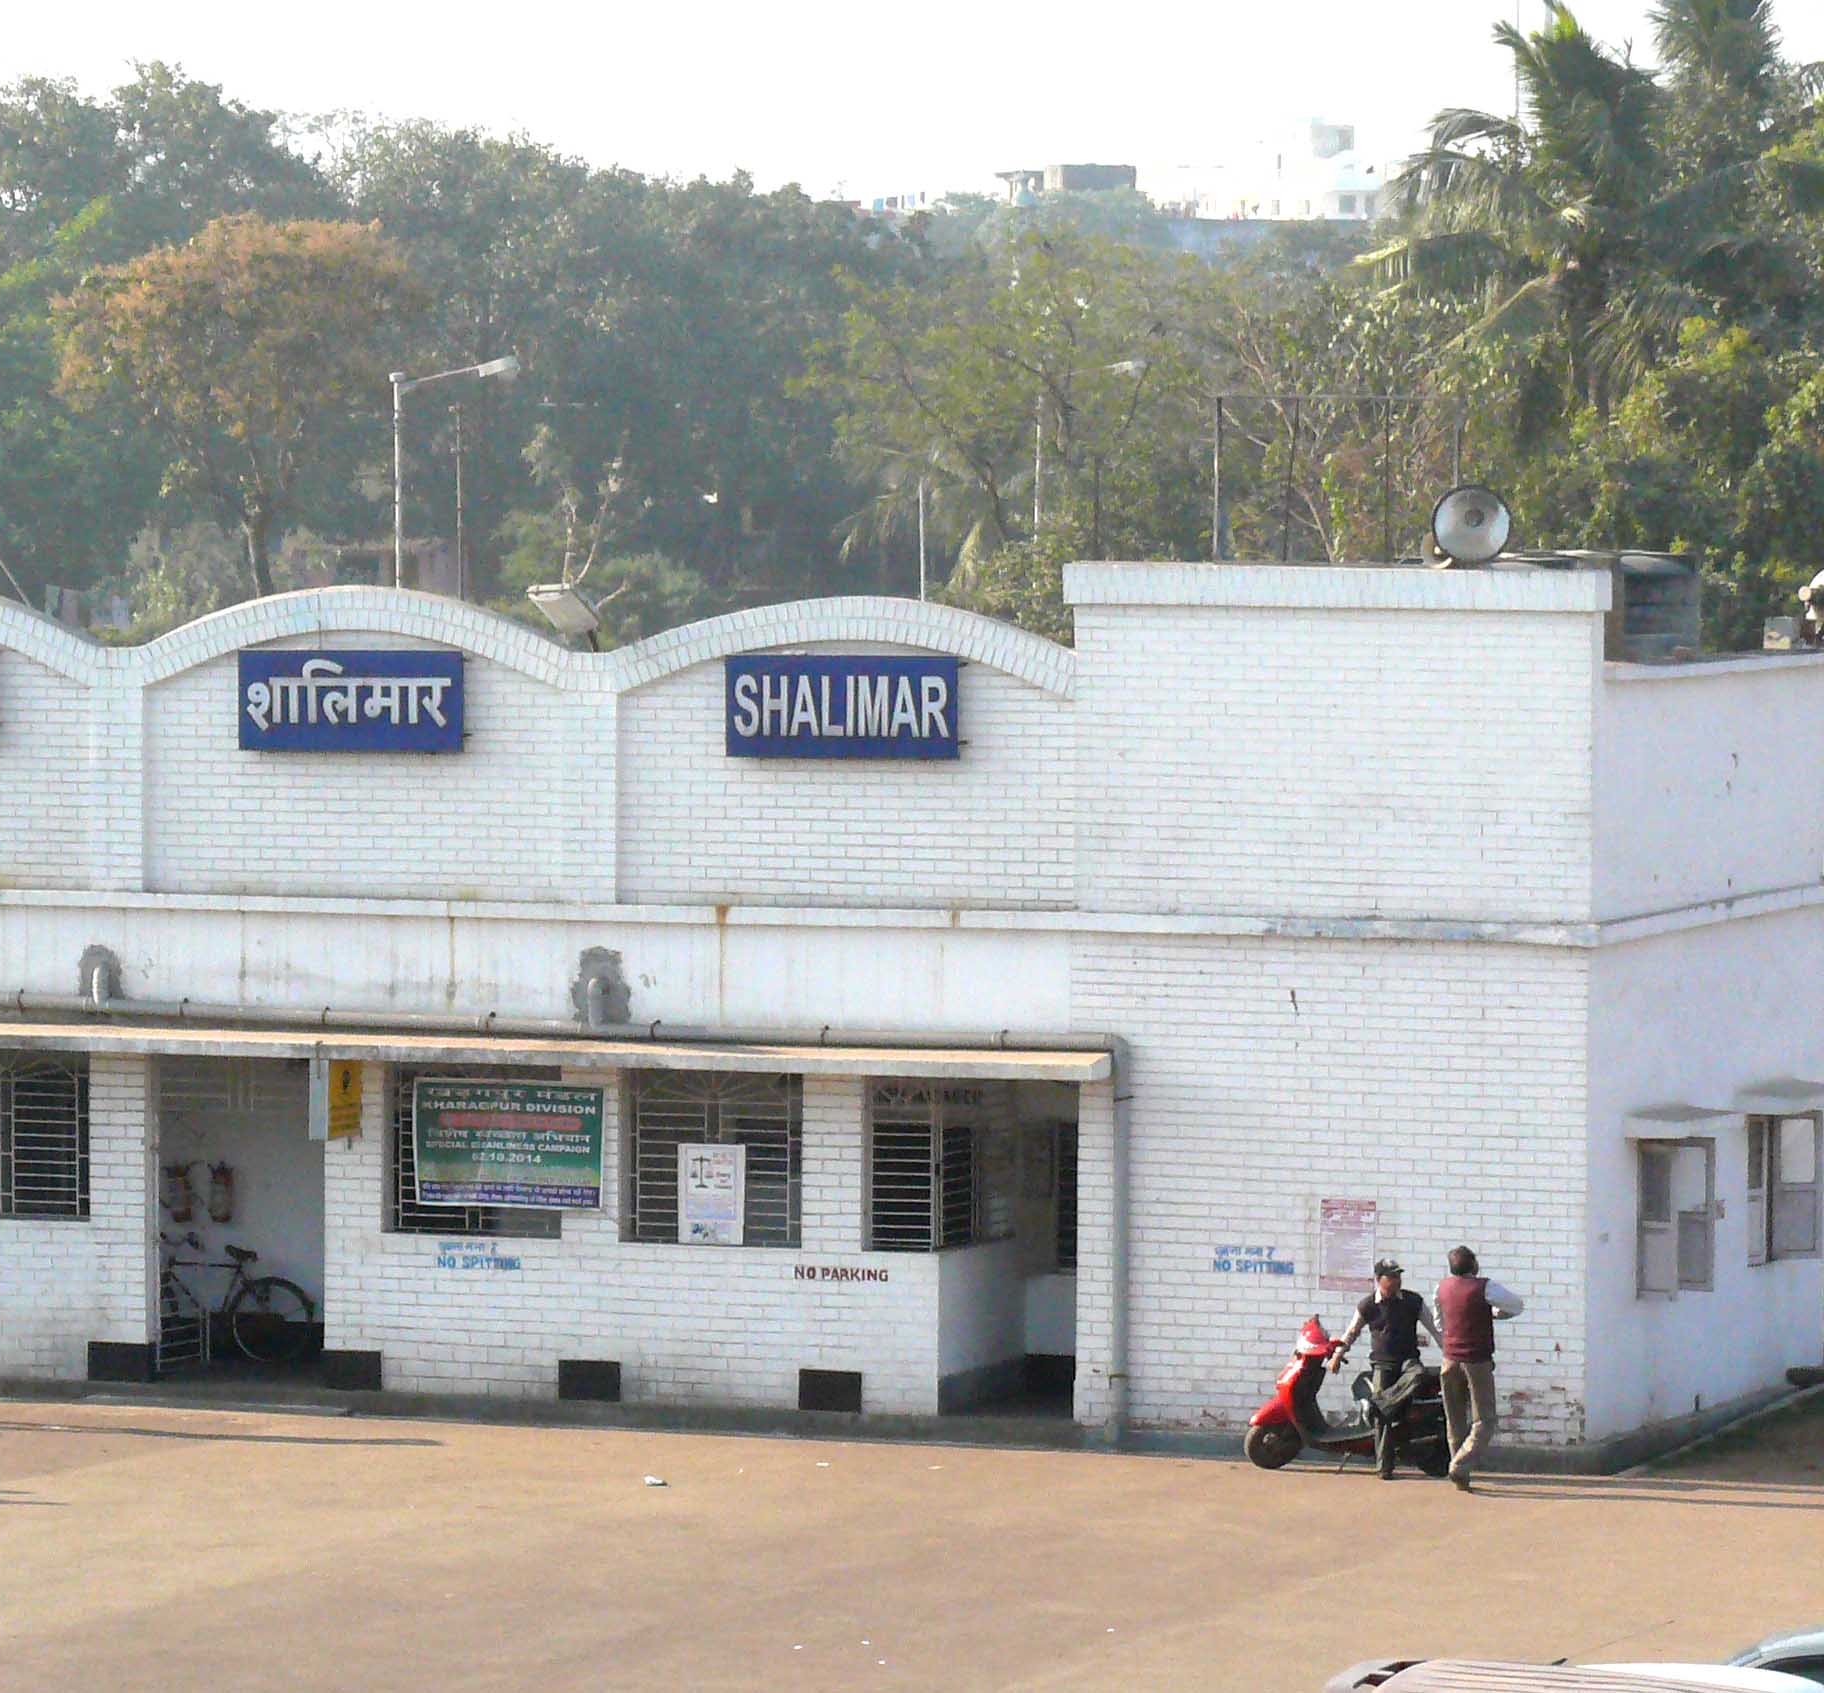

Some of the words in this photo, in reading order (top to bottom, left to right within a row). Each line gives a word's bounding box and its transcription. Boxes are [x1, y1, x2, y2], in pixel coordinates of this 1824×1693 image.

[246, 658, 452, 731] शालिमार
[733, 674, 949, 738] SHALIMAR
[526, 1103, 596, 1115] DIVISION
[537, 1143, 591, 1154] CAMPAIGN
[437, 1255, 456, 1269] NO
[1213, 1259, 1232, 1272] NO
[1236, 1259, 1294, 1275] SPITTING
[794, 1265, 816, 1279] NO
[821, 1267, 888, 1282] PARKING
